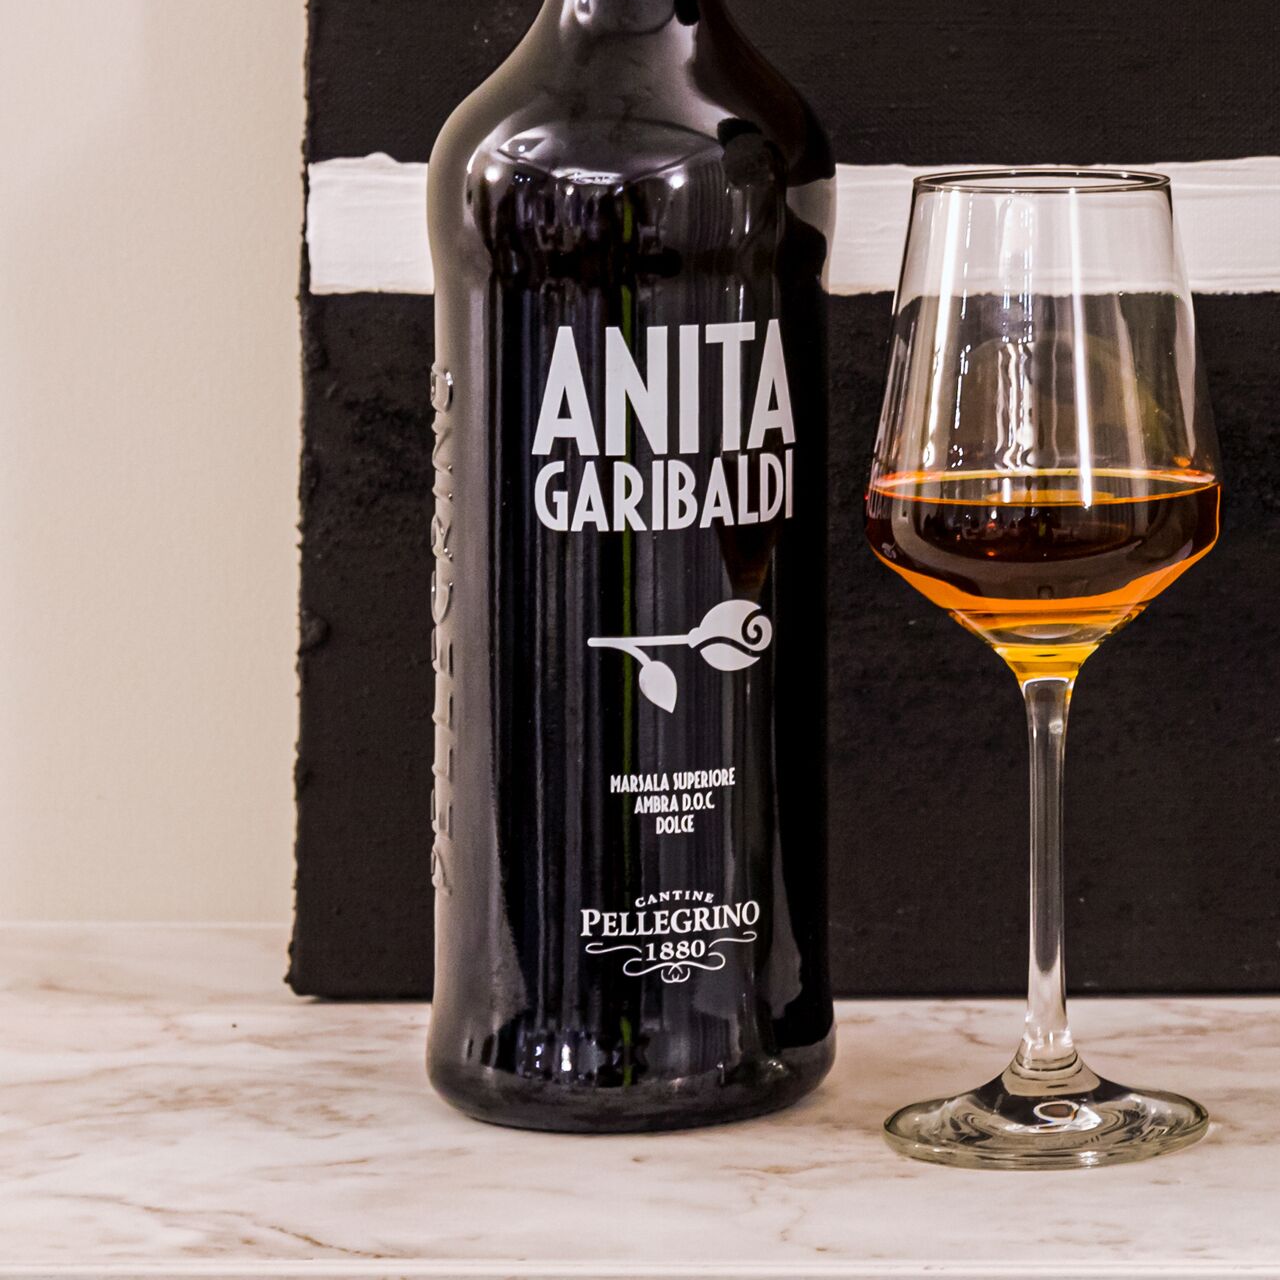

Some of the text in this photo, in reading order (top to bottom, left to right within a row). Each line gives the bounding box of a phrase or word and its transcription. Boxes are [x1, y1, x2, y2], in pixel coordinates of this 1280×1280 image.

[531, 319, 796, 456] ANITA
[534, 448, 793, 532] GARIBALDI
[610, 767, 736, 793] MARSALA SUPERIORE
[634, 795, 679, 814] AMBRA
[655, 814, 695, 835] DOLCE
[634, 890, 715, 908] CANTINE
[580, 900, 760, 937] PELLEGRINO
[645, 939, 706, 961] 1880
